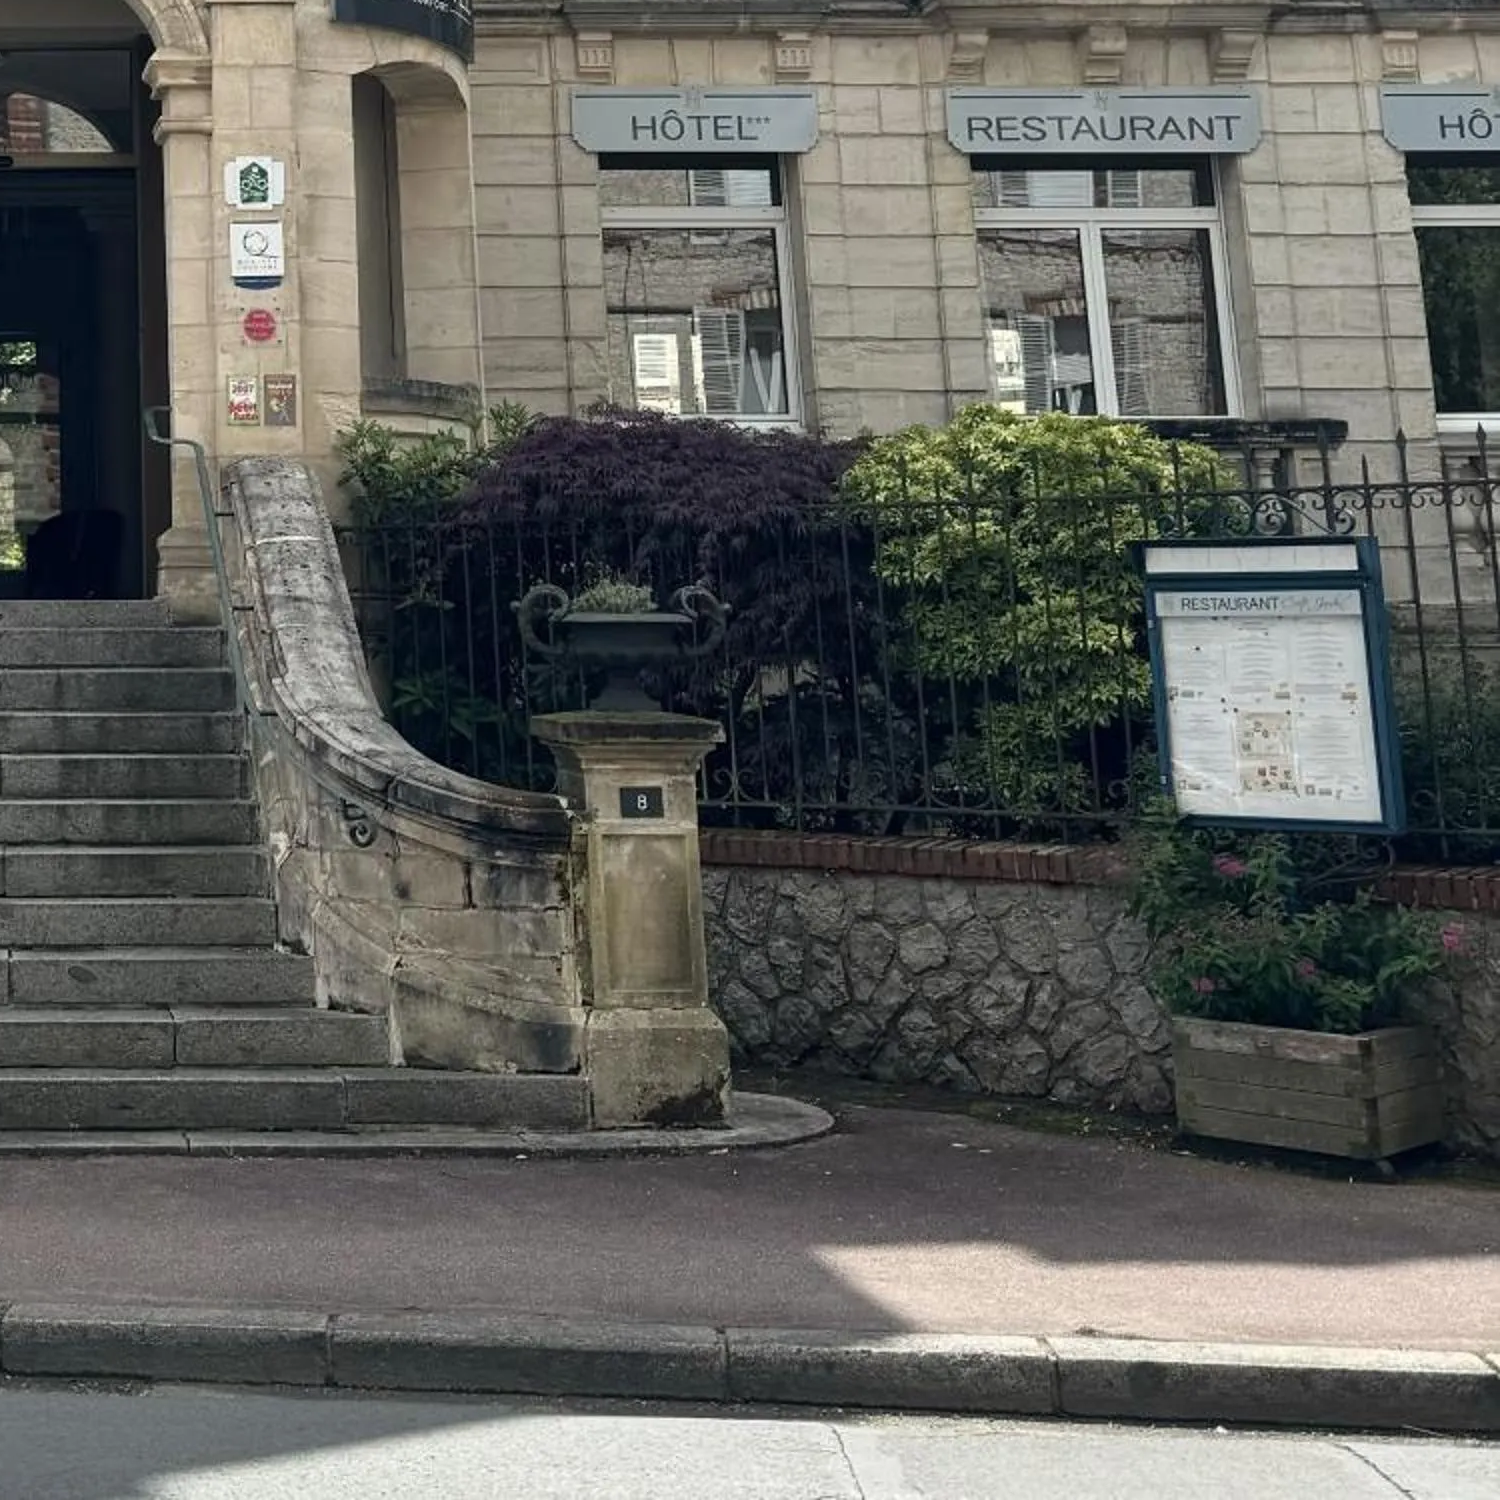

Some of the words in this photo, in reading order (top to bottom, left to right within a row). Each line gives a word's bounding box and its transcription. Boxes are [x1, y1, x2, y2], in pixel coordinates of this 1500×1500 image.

[630, 108, 760, 141] HÔTEL
[966, 115, 1242, 142] RESTAURANT
[1180, 596, 1280, 612] RESTAURANT
[636, 793, 648, 811] 8
